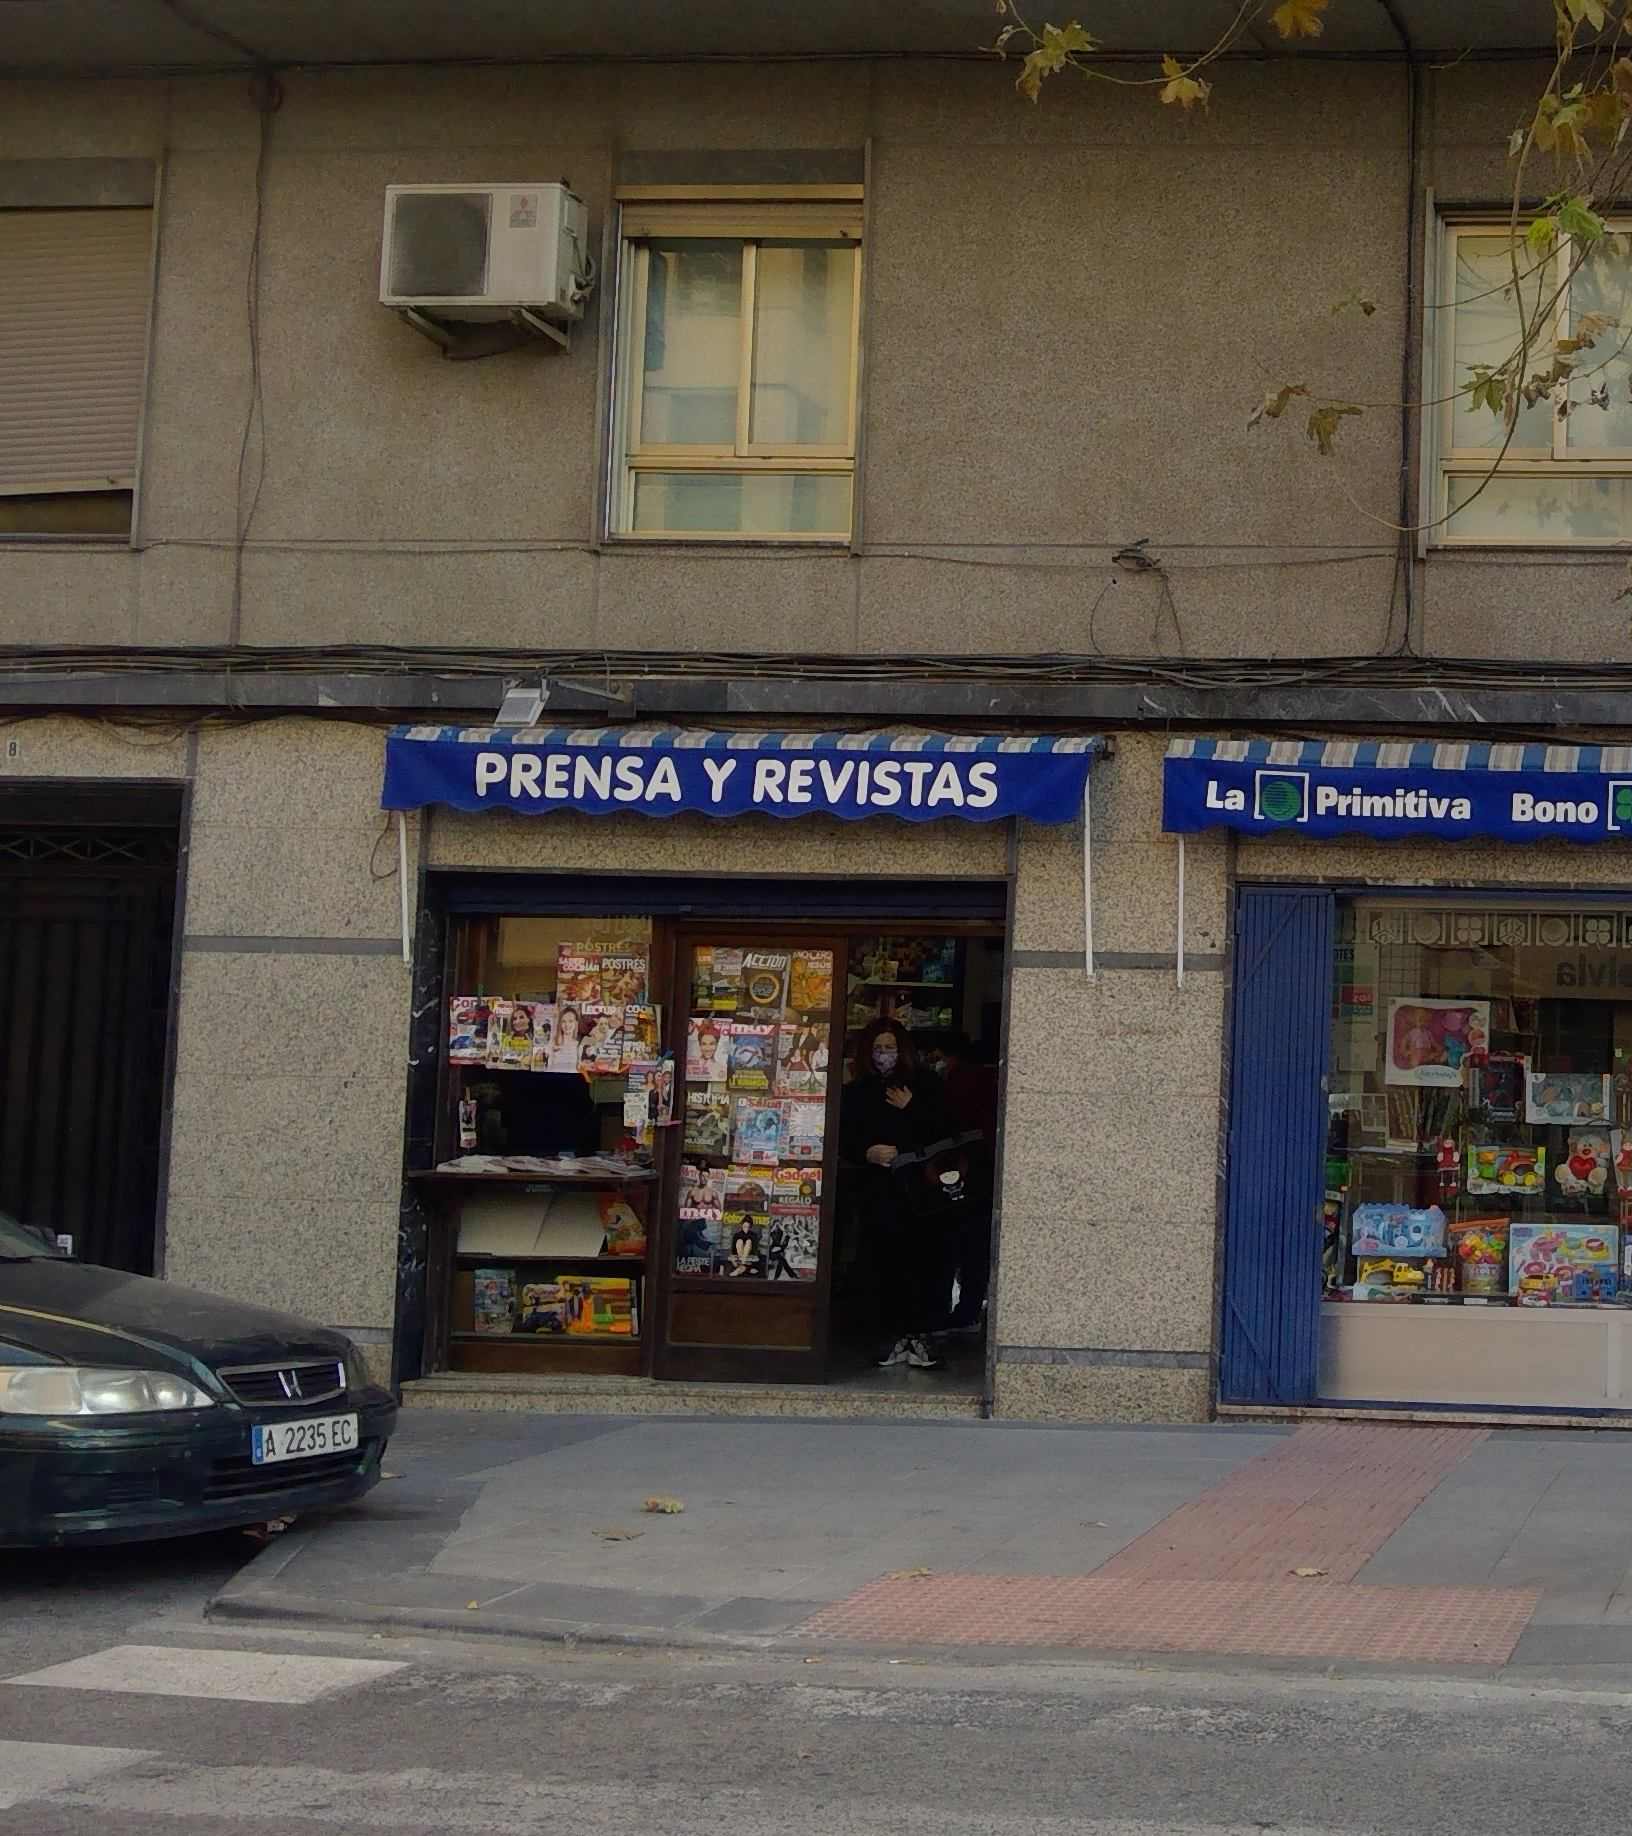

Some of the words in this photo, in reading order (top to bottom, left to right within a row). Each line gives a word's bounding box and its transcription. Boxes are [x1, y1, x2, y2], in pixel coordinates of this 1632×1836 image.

[475, 751, 682, 802] PRENSA
[703, 758, 737, 802] Y
[753, 759, 999, 808] REVISTAS
[1206, 780, 1245, 811] La
[1316, 785, 1472, 820] Primitiva
[1511, 792, 1599, 824] Bono
[264, 1429, 277, 1457] A
[285, 1422, 327, 1454] 2235
[331, 1419, 352, 1446] EC
